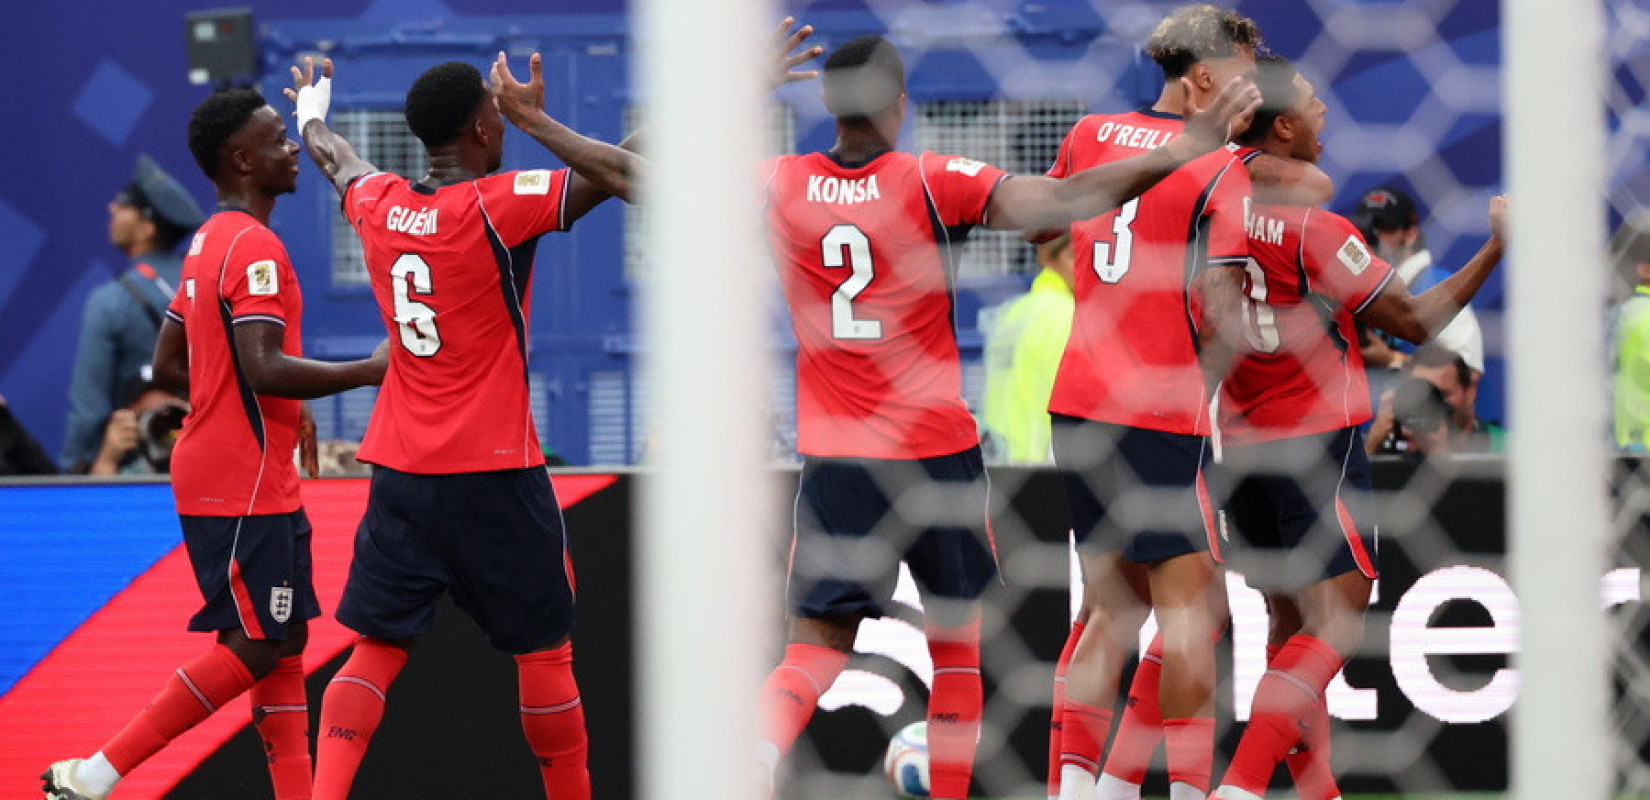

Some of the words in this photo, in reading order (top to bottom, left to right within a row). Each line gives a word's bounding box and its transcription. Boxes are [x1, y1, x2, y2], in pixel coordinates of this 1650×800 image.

[807, 174, 881, 204] KONSA
[821, 223, 883, 340] 2
[1094, 197, 1141, 284] 3
[389, 252, 444, 358] 6
[328, 726, 357, 741] ENG
